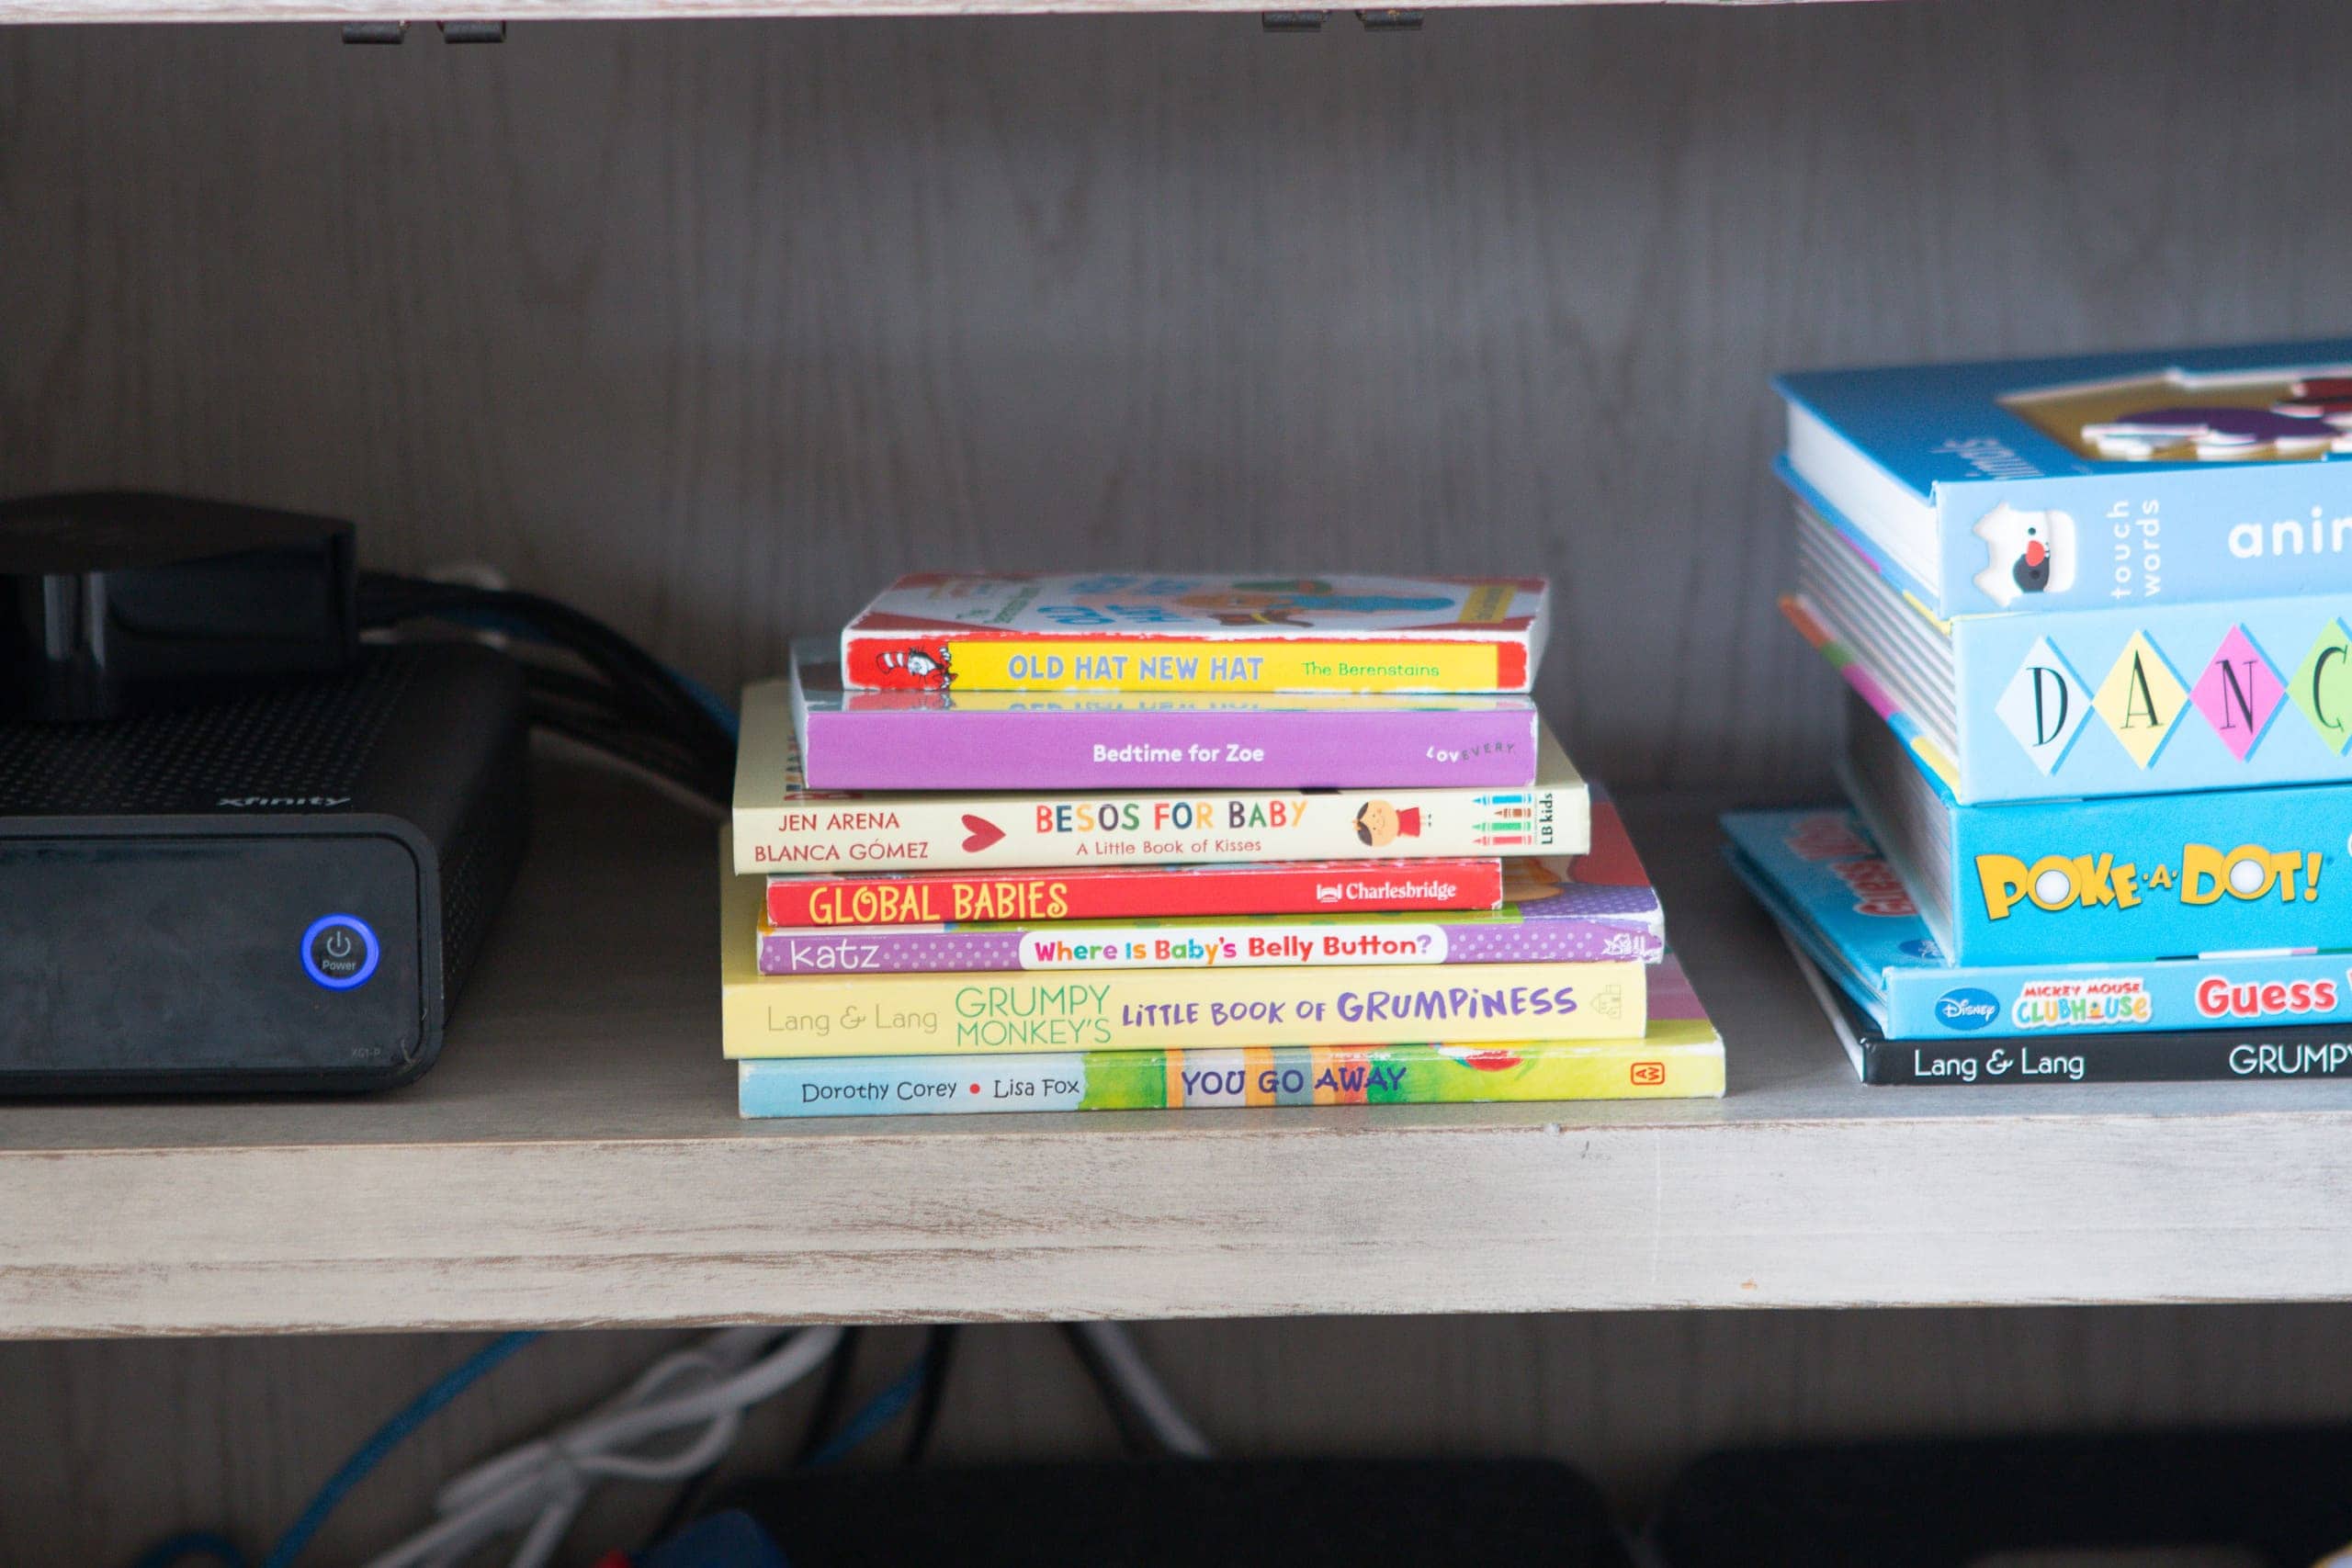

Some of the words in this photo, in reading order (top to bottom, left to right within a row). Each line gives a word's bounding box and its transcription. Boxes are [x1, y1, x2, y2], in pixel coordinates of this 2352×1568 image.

[2107, 501, 2132, 599] touch
[2135, 500, 2161, 597] words
[1009, 655, 1064, 680] OLD
[1075, 655, 1128, 681] HAT
[1139, 656, 1198, 681] NEW
[1209, 656, 1264, 681] HAT
[1302, 661, 1332, 677] The
[1338, 661, 1440, 677] Berenstains
[1093, 744, 1182, 763] Bedtime
[1188, 744, 1221, 762] for
[1226, 744, 1264, 762] Zoe
[217, 796, 351, 807] xfinity
[1539, 793, 1553, 822] kids
[779, 814, 817, 832] JEN
[826, 812, 900, 830] ARENA
[1036, 803, 1140, 833] BESOS
[1155, 802, 1214, 831] FOR
[1228, 800, 1308, 829] BABY
[1076, 841, 1089, 855] A
[1095, 840, 1135, 855] Little
[1143, 840, 1183, 854] Book
[1192, 840, 1208, 853] of
[1215, 838, 1261, 852] Kisses
[1541, 826, 1553, 844] LB
[754, 843, 840, 862] BLANCA
[849, 838, 928, 860] GÓMEZ
[808, 885, 940, 925] GLOBAL
[953, 881, 1069, 921] BABIES
[1346, 882, 1456, 901] Charlesbridge
[791, 938, 880, 970] katz
[1035, 940, 1117, 964] Where
[1125, 941, 1147, 961] Is
[1155, 936, 1237, 965] Baby's
[1249, 935, 1313, 963] Belly
[1323, 934, 1432, 955] Button?
[322, 959, 356, 970] Power
[956, 985, 1111, 1018] GRUMPY
[2025, 985, 2081, 998] MICKEY
[2087, 982, 2140, 995] MOUSE
[2197, 977, 2336, 1016] Guess
[768, 1006, 830, 1035] Lang
[840, 1006, 866, 1029] &
[875, 1003, 938, 1033] Lang
[1212, 1000, 1284, 1025] BOOK
[1295, 999, 1326, 1021] OF
[956, 1020, 1111, 1047] MONKEY'S
[1916, 1049, 1977, 1081] Lang
[1985, 1049, 2014, 1075] &
[2022, 1047, 2085, 1080] Lang
[2229, 1043, 2352, 1074] GRUMP
[802, 1079, 888, 1104] Dorothy
[897, 1079, 956, 1101] Corey
[994, 1078, 1035, 1099] Lisa
[1044, 1077, 1080, 1097] Fox
[1182, 1070, 1245, 1096] YOU
[1259, 1068, 1304, 1094] GO
[1315, 1066, 1408, 1092] AWAY
